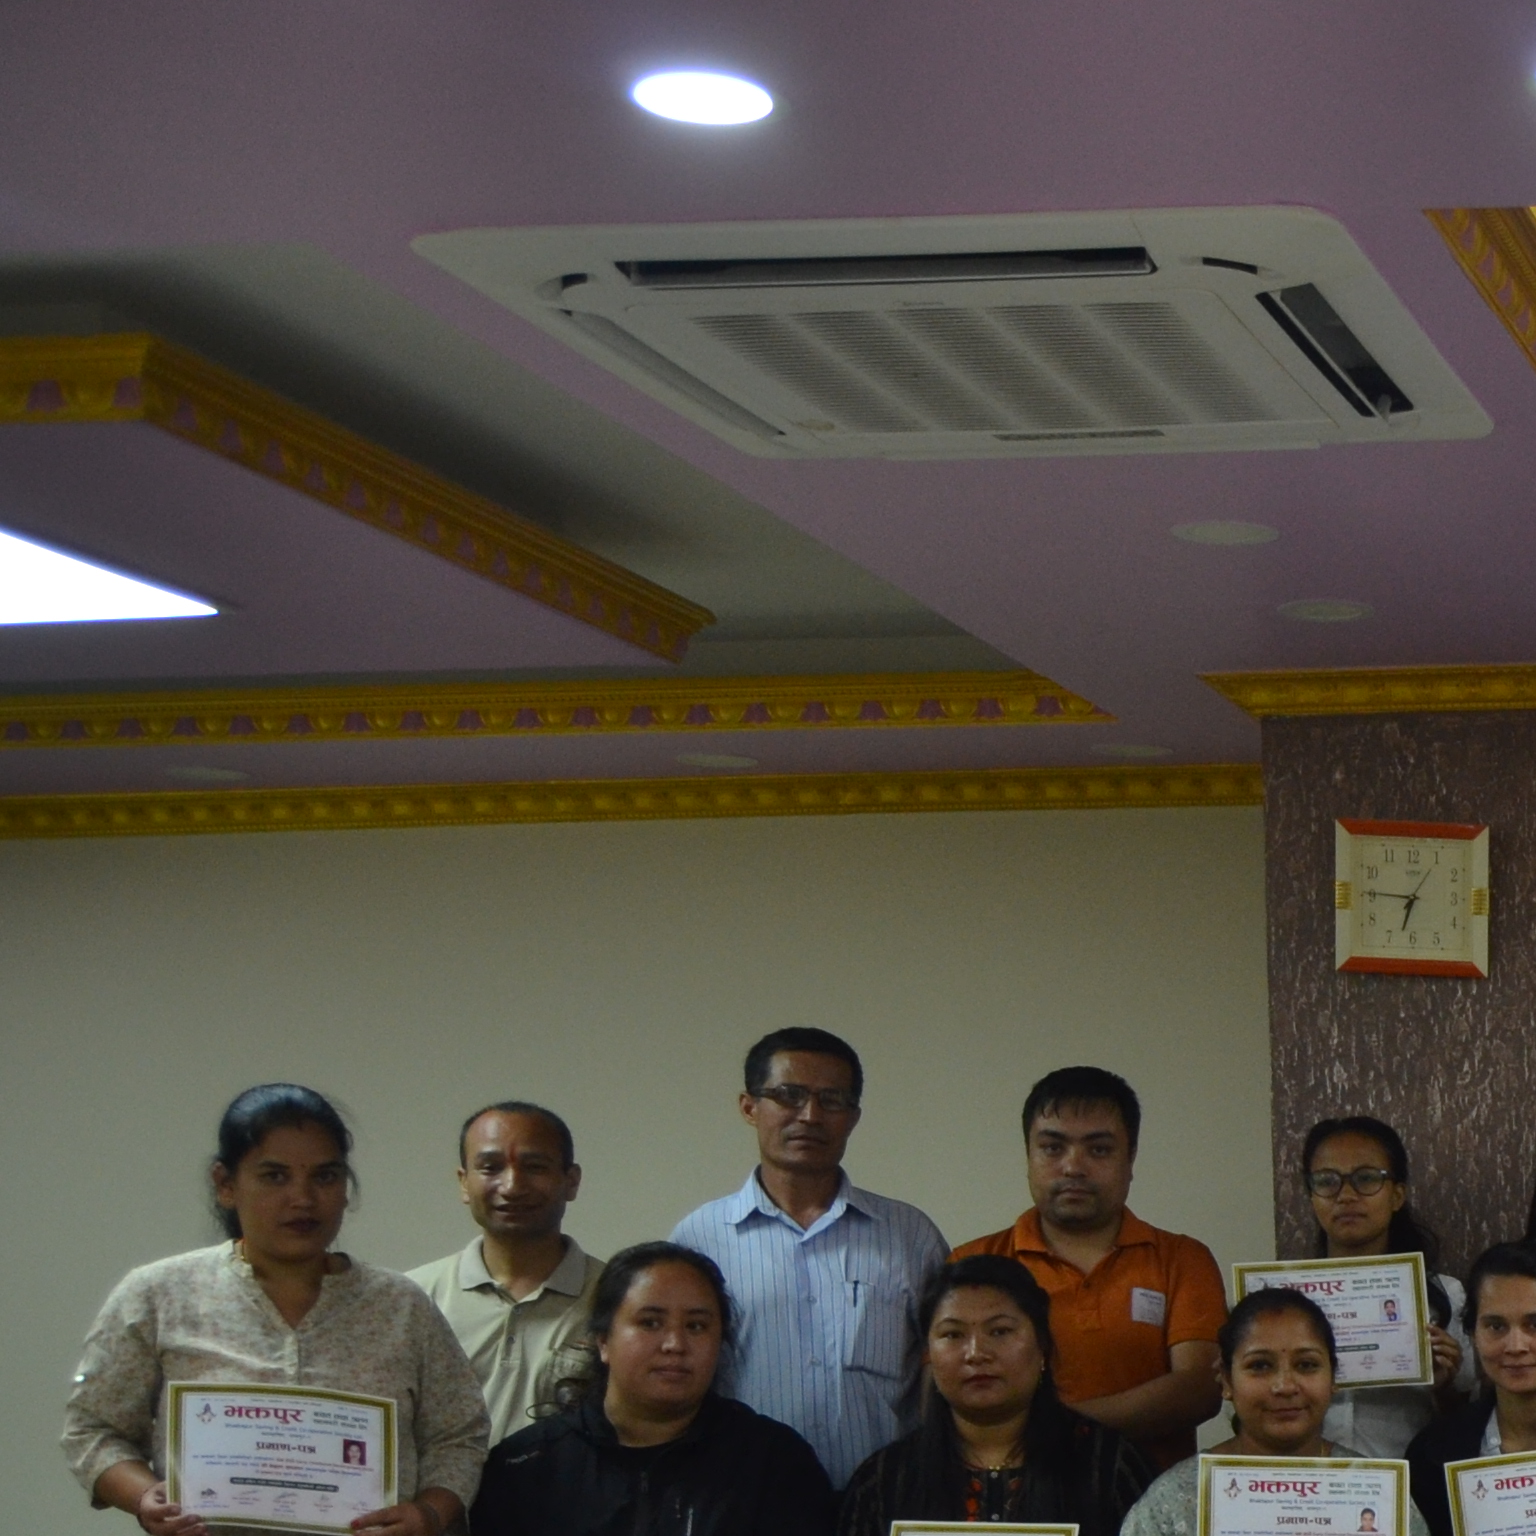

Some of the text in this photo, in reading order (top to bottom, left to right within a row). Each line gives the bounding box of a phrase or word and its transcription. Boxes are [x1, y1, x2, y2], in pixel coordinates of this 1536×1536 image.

[1384, 849, 1394, 863] 11
[1407, 849, 1420, 864] 12
[1433, 851, 1439, 865] 1
[1366, 866, 1378, 880] 10
[1451, 868, 1458, 882] 2
[1451, 891, 1458, 906] 3
[1369, 912, 1376, 926] 8
[1450, 916, 1458, 929] 4
[1386, 929, 1393, 944] 7
[1409, 931, 1417, 945] 6
[1433, 932, 1440, 946] 5
[225, 1405, 305, 1424] भक्तपुर
[1249, 1480, 1321, 1497] भक्तपुर
